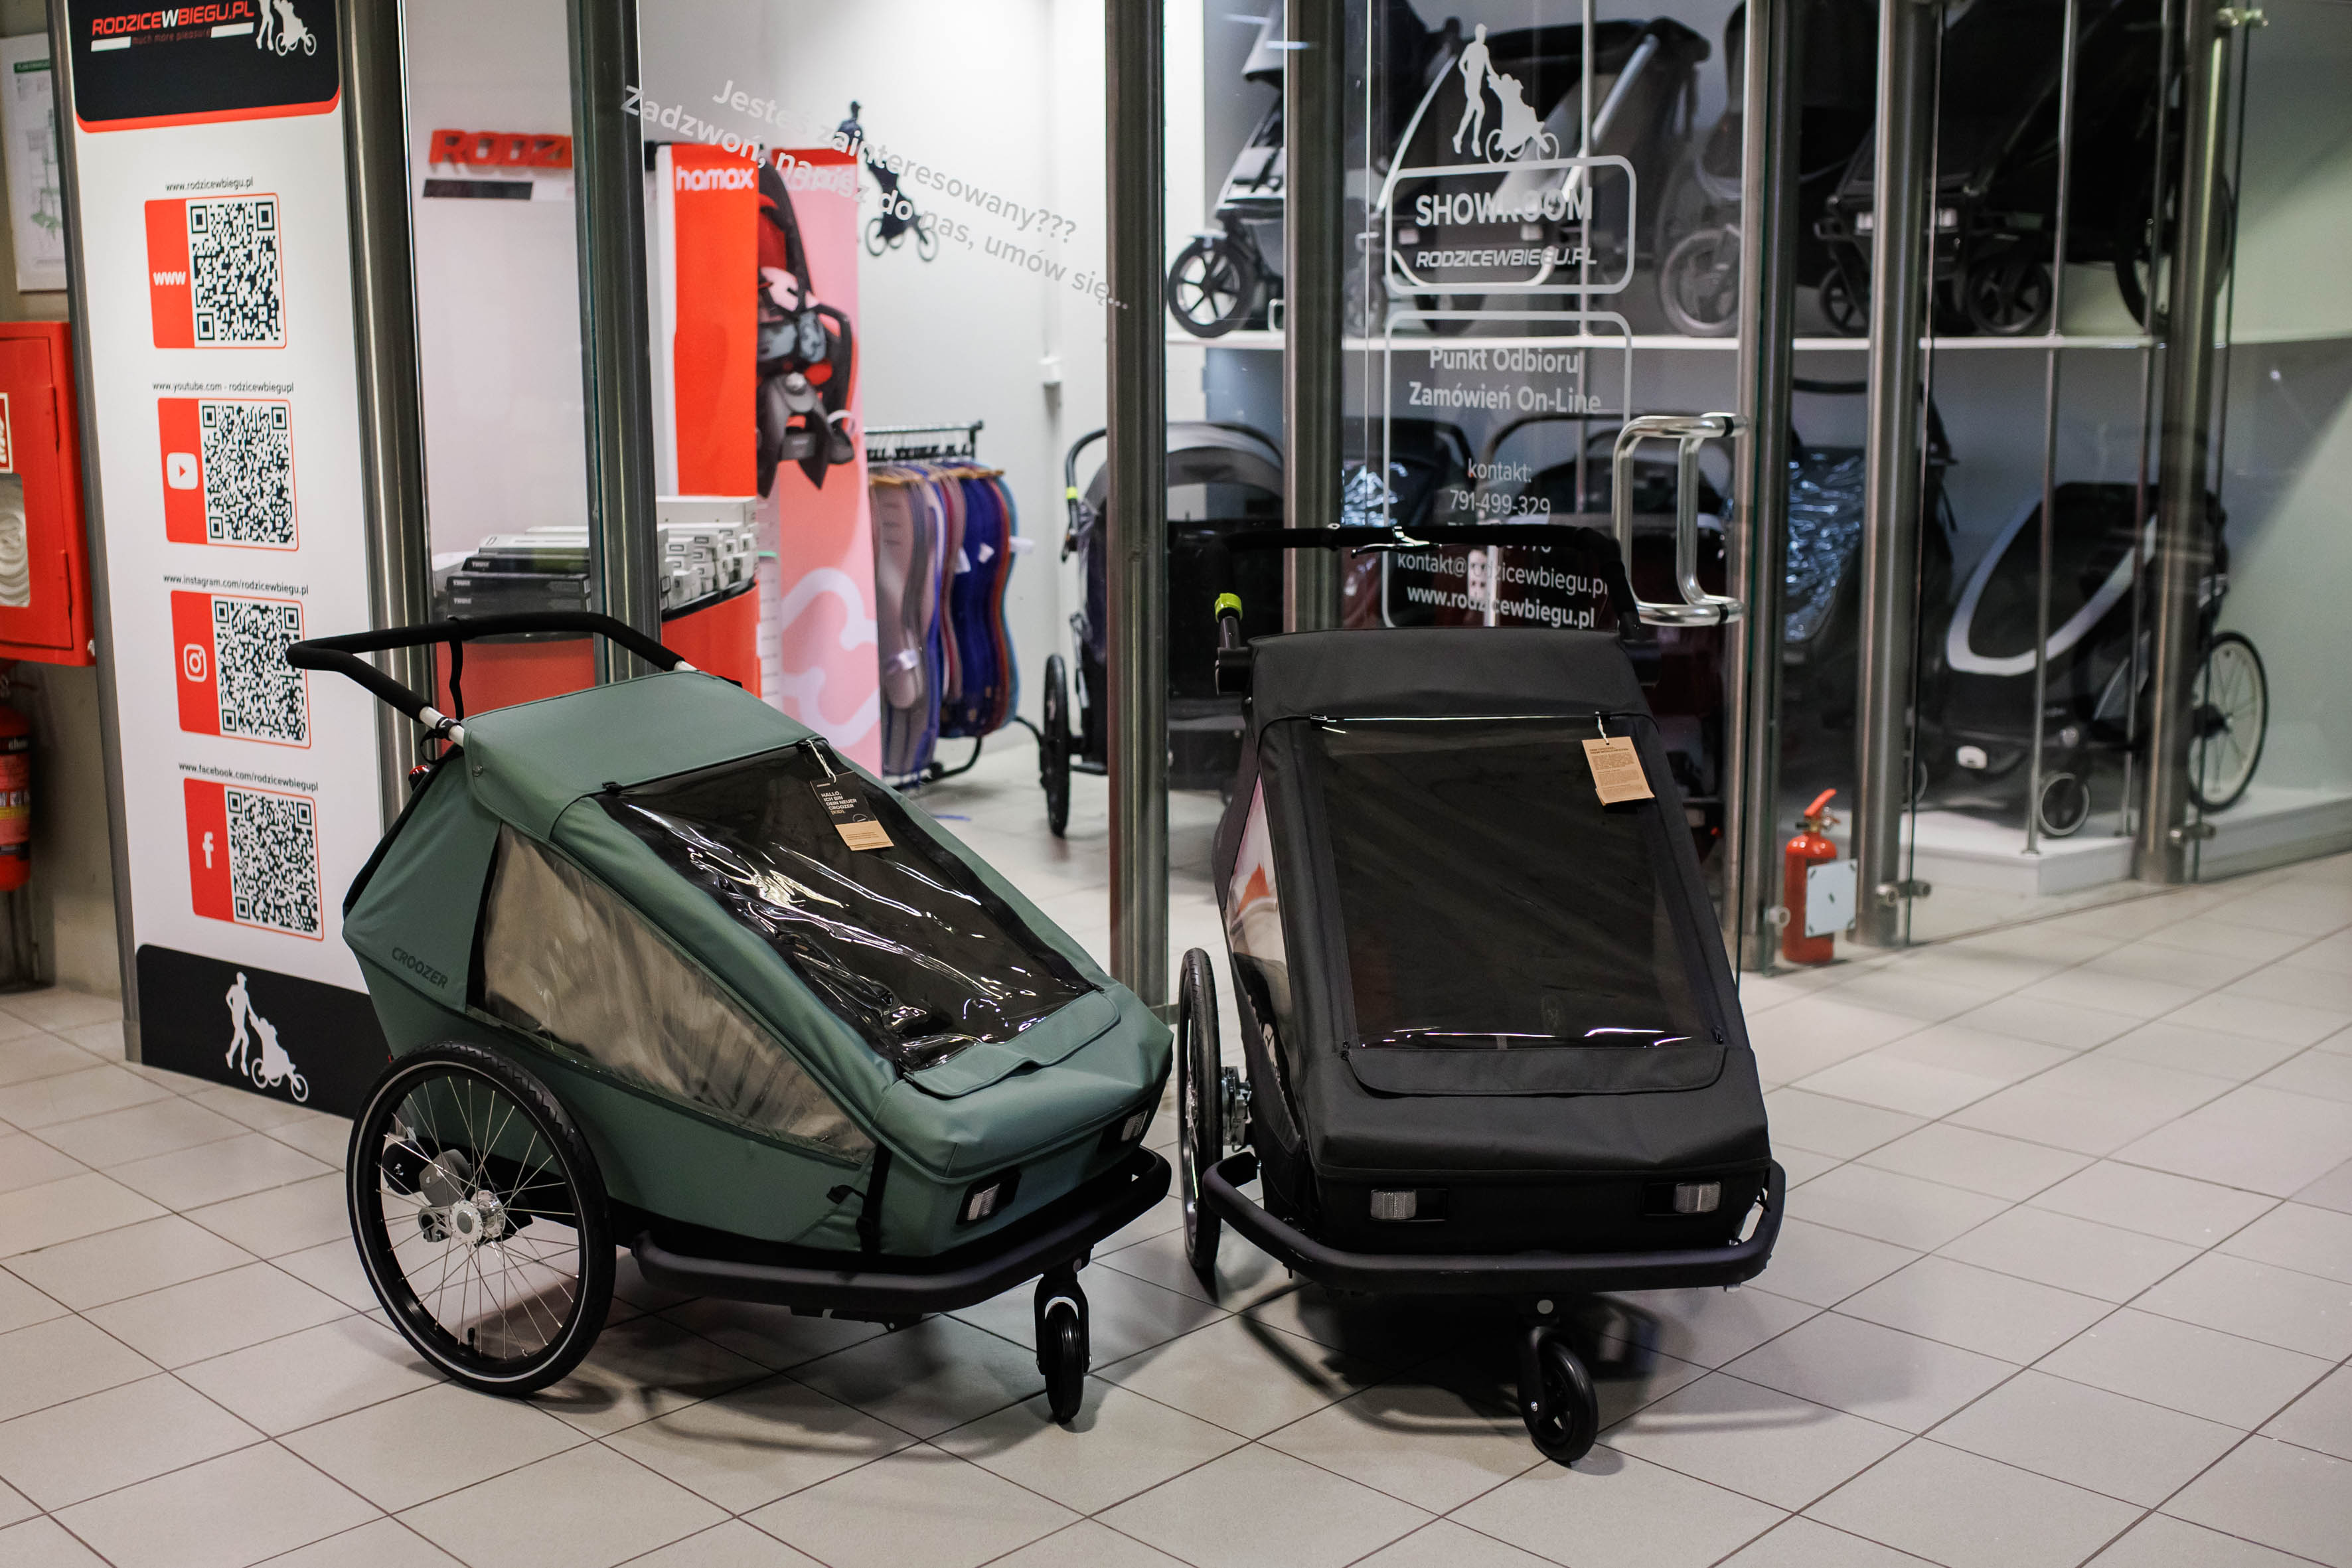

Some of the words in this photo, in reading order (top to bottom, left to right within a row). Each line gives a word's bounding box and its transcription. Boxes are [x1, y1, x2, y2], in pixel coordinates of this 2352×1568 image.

[92, 1, 255, 36] RODZICEWBIEGU.PL
[165, 177, 254, 191] www.rodzicewbiegu.pl
[621, 85, 766, 168] Zadzwoń,
[878, 189, 913, 220] do
[919, 209, 975, 250] nas,
[984, 236, 1067, 281] umów
[1071, 270, 1128, 309] się...
[817, 124, 1077, 243] zainteresowany???
[1415, 187, 1592, 226] SHOWROOM
[1416, 248, 1597, 268] RODZICEWBIEGU.PL
[153, 272, 186, 285] www
[1430, 347, 1487, 370] Punkt
[1493, 347, 1579, 373] Odbioru
[152, 382, 222, 392] www.youtube.com
[228, 382, 294, 394] rodzicewbiegupl
[1409, 381, 1511, 410] Zamówień
[1517, 385, 1601, 414] On-Line
[1468, 458, 1531, 483] kontakt:
[1450, 489, 1551, 518] 791-499-329
[163, 574, 309, 596] www.instagram.com/rodzicewbiegu.pl
[1397, 553, 1608, 597] kontakt@odzicewbiegu.p
[1407, 586, 1595, 629] www.rodzcewbiegu.pl
[178, 762, 319, 791] www.facebook.com/rodzicewbiegupl
[392, 947, 448, 988] CROOZER
